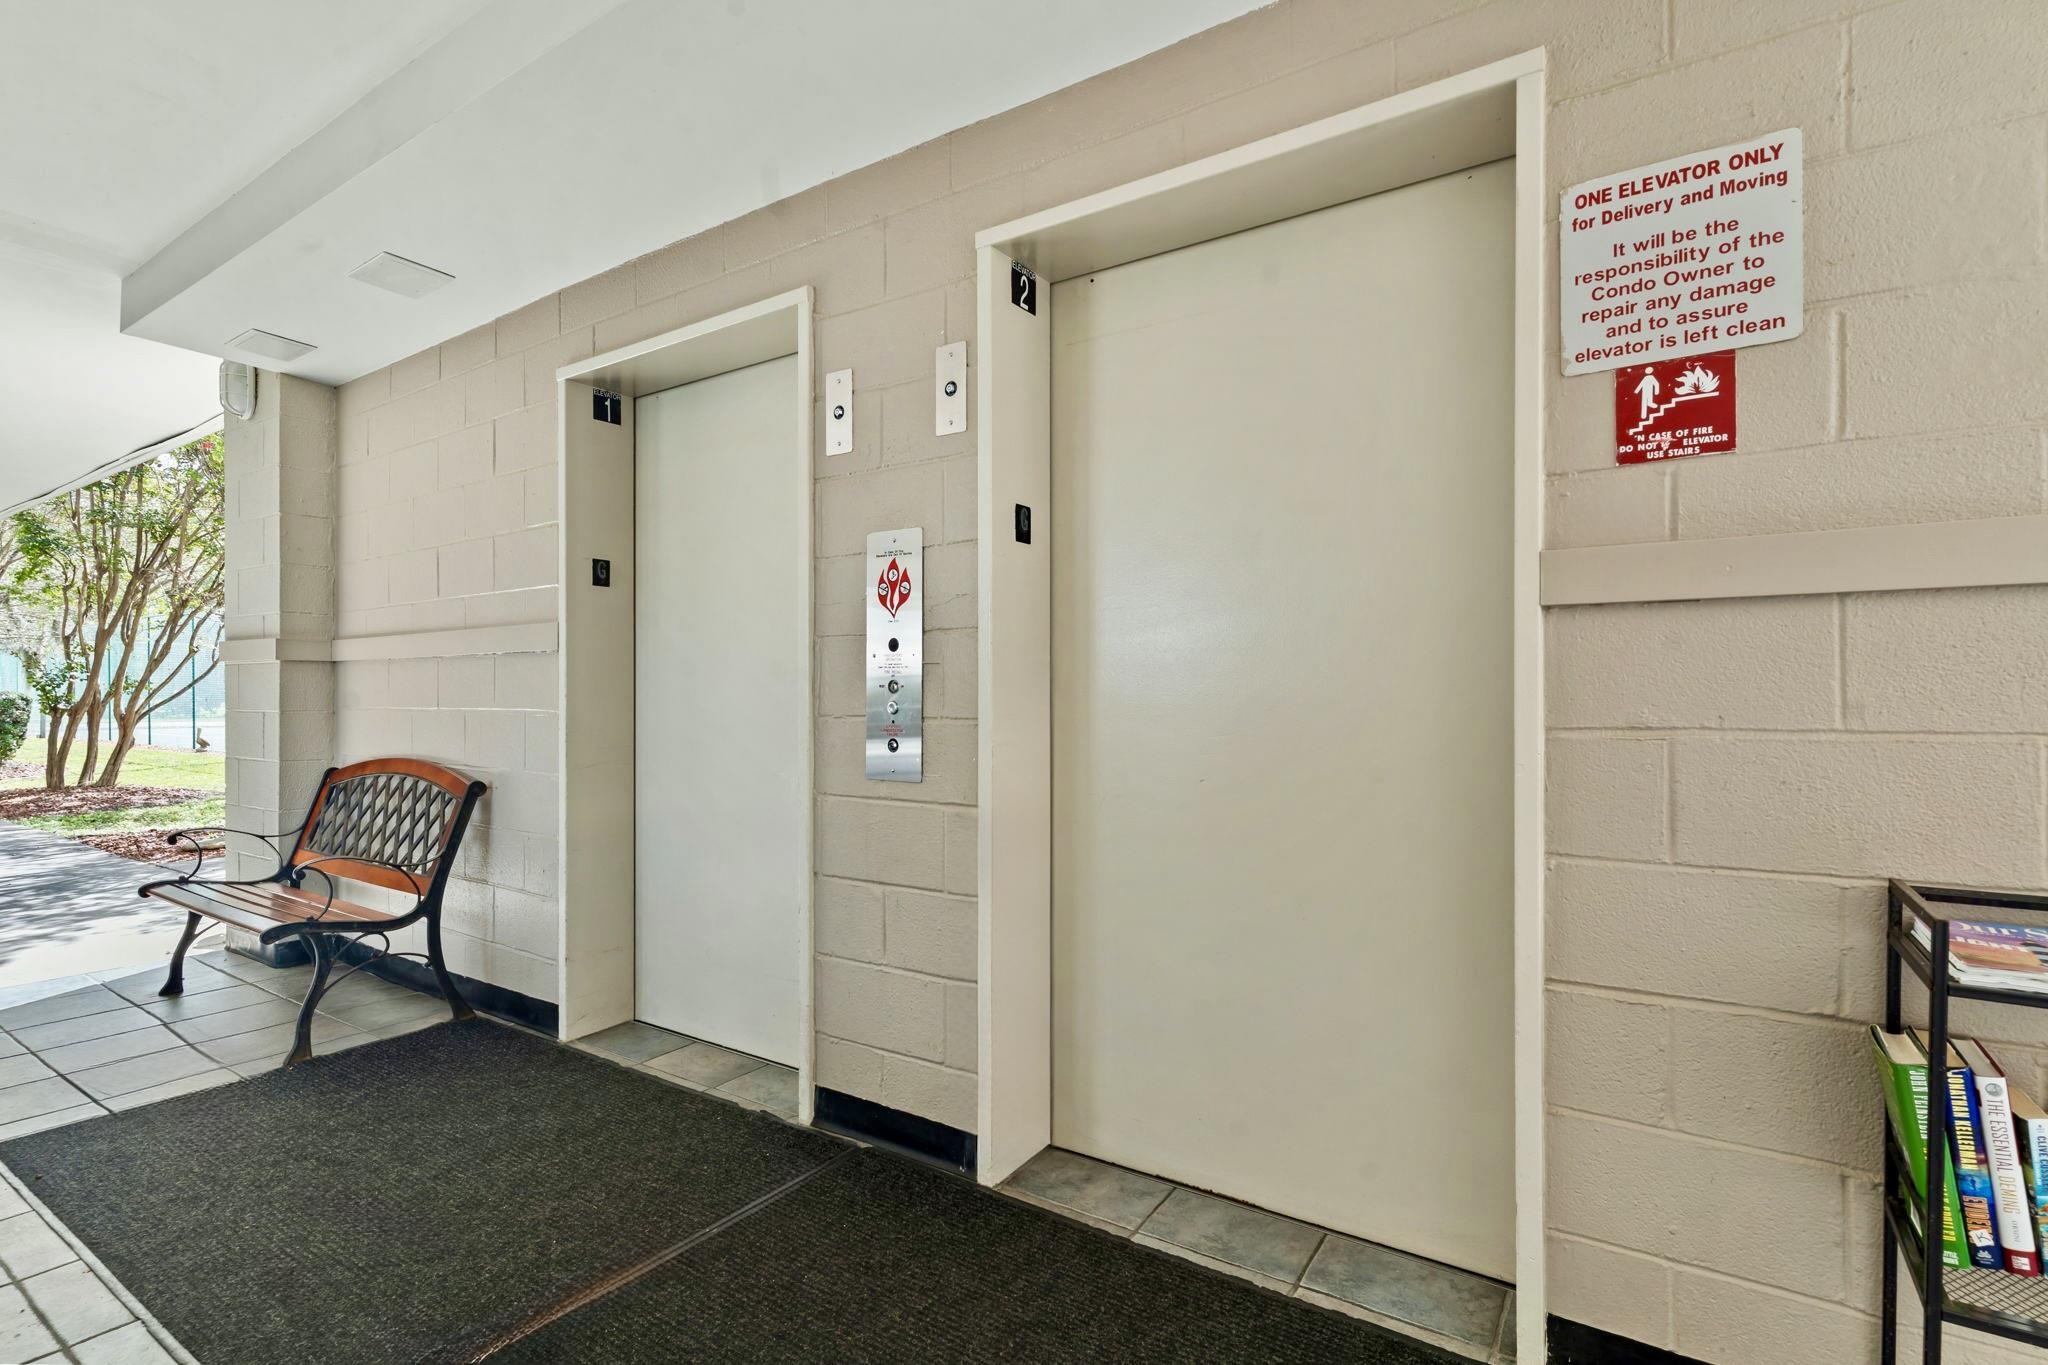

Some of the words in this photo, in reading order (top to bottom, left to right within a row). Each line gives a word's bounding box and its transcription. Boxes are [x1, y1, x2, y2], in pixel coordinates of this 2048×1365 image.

[1574, 187, 1612, 210] ONE
[1618, 160, 1721, 200] ELEVATOR
[1728, 143, 1784, 171] ONLY
[1571, 218, 1596, 231] for
[1601, 199, 1674, 225] Delivery
[1680, 185, 1714, 206] and
[1719, 171, 1788, 197] Moving
[1612, 244, 1626, 256] It
[1633, 234, 1665, 252] will
[1671, 230, 1697, 245] be
[1705, 220, 1740, 238] the
[1574, 248, 1710, 285] responsibility
[1718, 237, 1741, 254] of
[1750, 231, 1785, 248] the
[1020, 275, 1029, 311] 2
[1590, 278, 1657, 301] Condo
[1663, 262, 1735, 288] Owner
[1743, 256, 1765, 271] to
[1581, 302, 1638, 323] repair
[1645, 295, 1682, 310] any
[1689, 276, 1776, 302] damage
[1606, 320, 1643, 338] and
[1649, 316, 1669, 331] to
[1676, 302, 1749, 325] assure
[1575, 340, 1653, 364] elevator
[1659, 336, 1677, 349] is
[1683, 326, 1718, 344] left
[1726, 317, 1787, 336] clean
[605, 398, 610, 422] 1
[1619, 445, 1634, 453] DO
[1637, 442, 1658, 451] NOT
[1683, 434, 1728, 446] ELEVATOR
[1634, 434, 1645, 442] N
[1648, 431, 1672, 440] CASE
[1675, 429, 1689, 438] OF
[1692, 426, 1713, 435] FIRE
[1647, 450, 1664, 459] USE
[1668, 446, 1700, 457] STAIRS
[1909, 1070, 1928, 1092] JOHN
[1947, 1070, 1970, 1118] JONATHAN
[1986, 1100, 2005, 1116] THE
[1954, 1120, 1979, 1170] KELLERMAN
[1990, 1121, 2014, 1172] ESSENTIAL
[2036, 1135, 2048, 1157] CLIVE
[1998, 1175, 2021, 1215] DEMING
